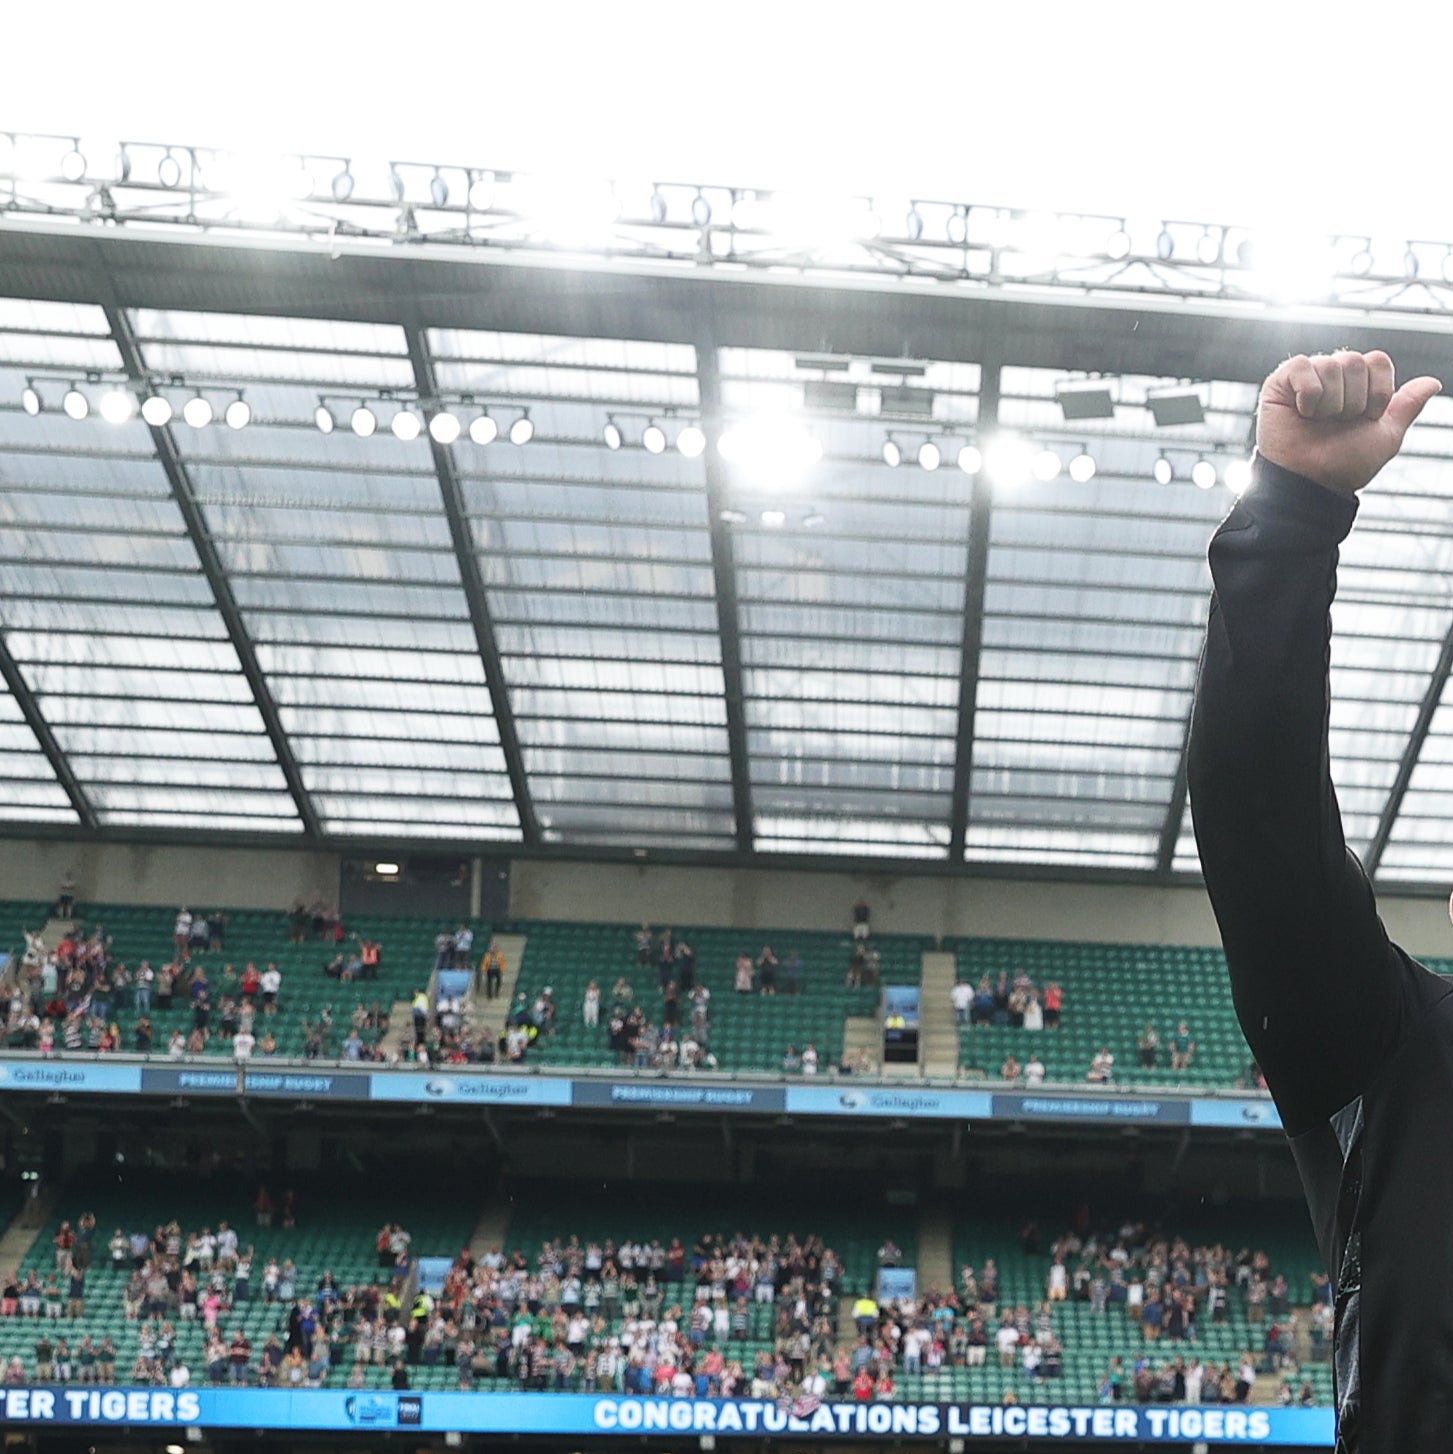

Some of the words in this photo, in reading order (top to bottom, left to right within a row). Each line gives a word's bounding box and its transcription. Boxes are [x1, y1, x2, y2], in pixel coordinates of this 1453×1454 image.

[64, 1390, 201, 1422] TIGERS
[594, 1400, 940, 1435] CONGRATULATIONS
[947, 1405, 1139, 1437] LEICESTER
[1145, 1409, 1272, 1440] TIGERS
